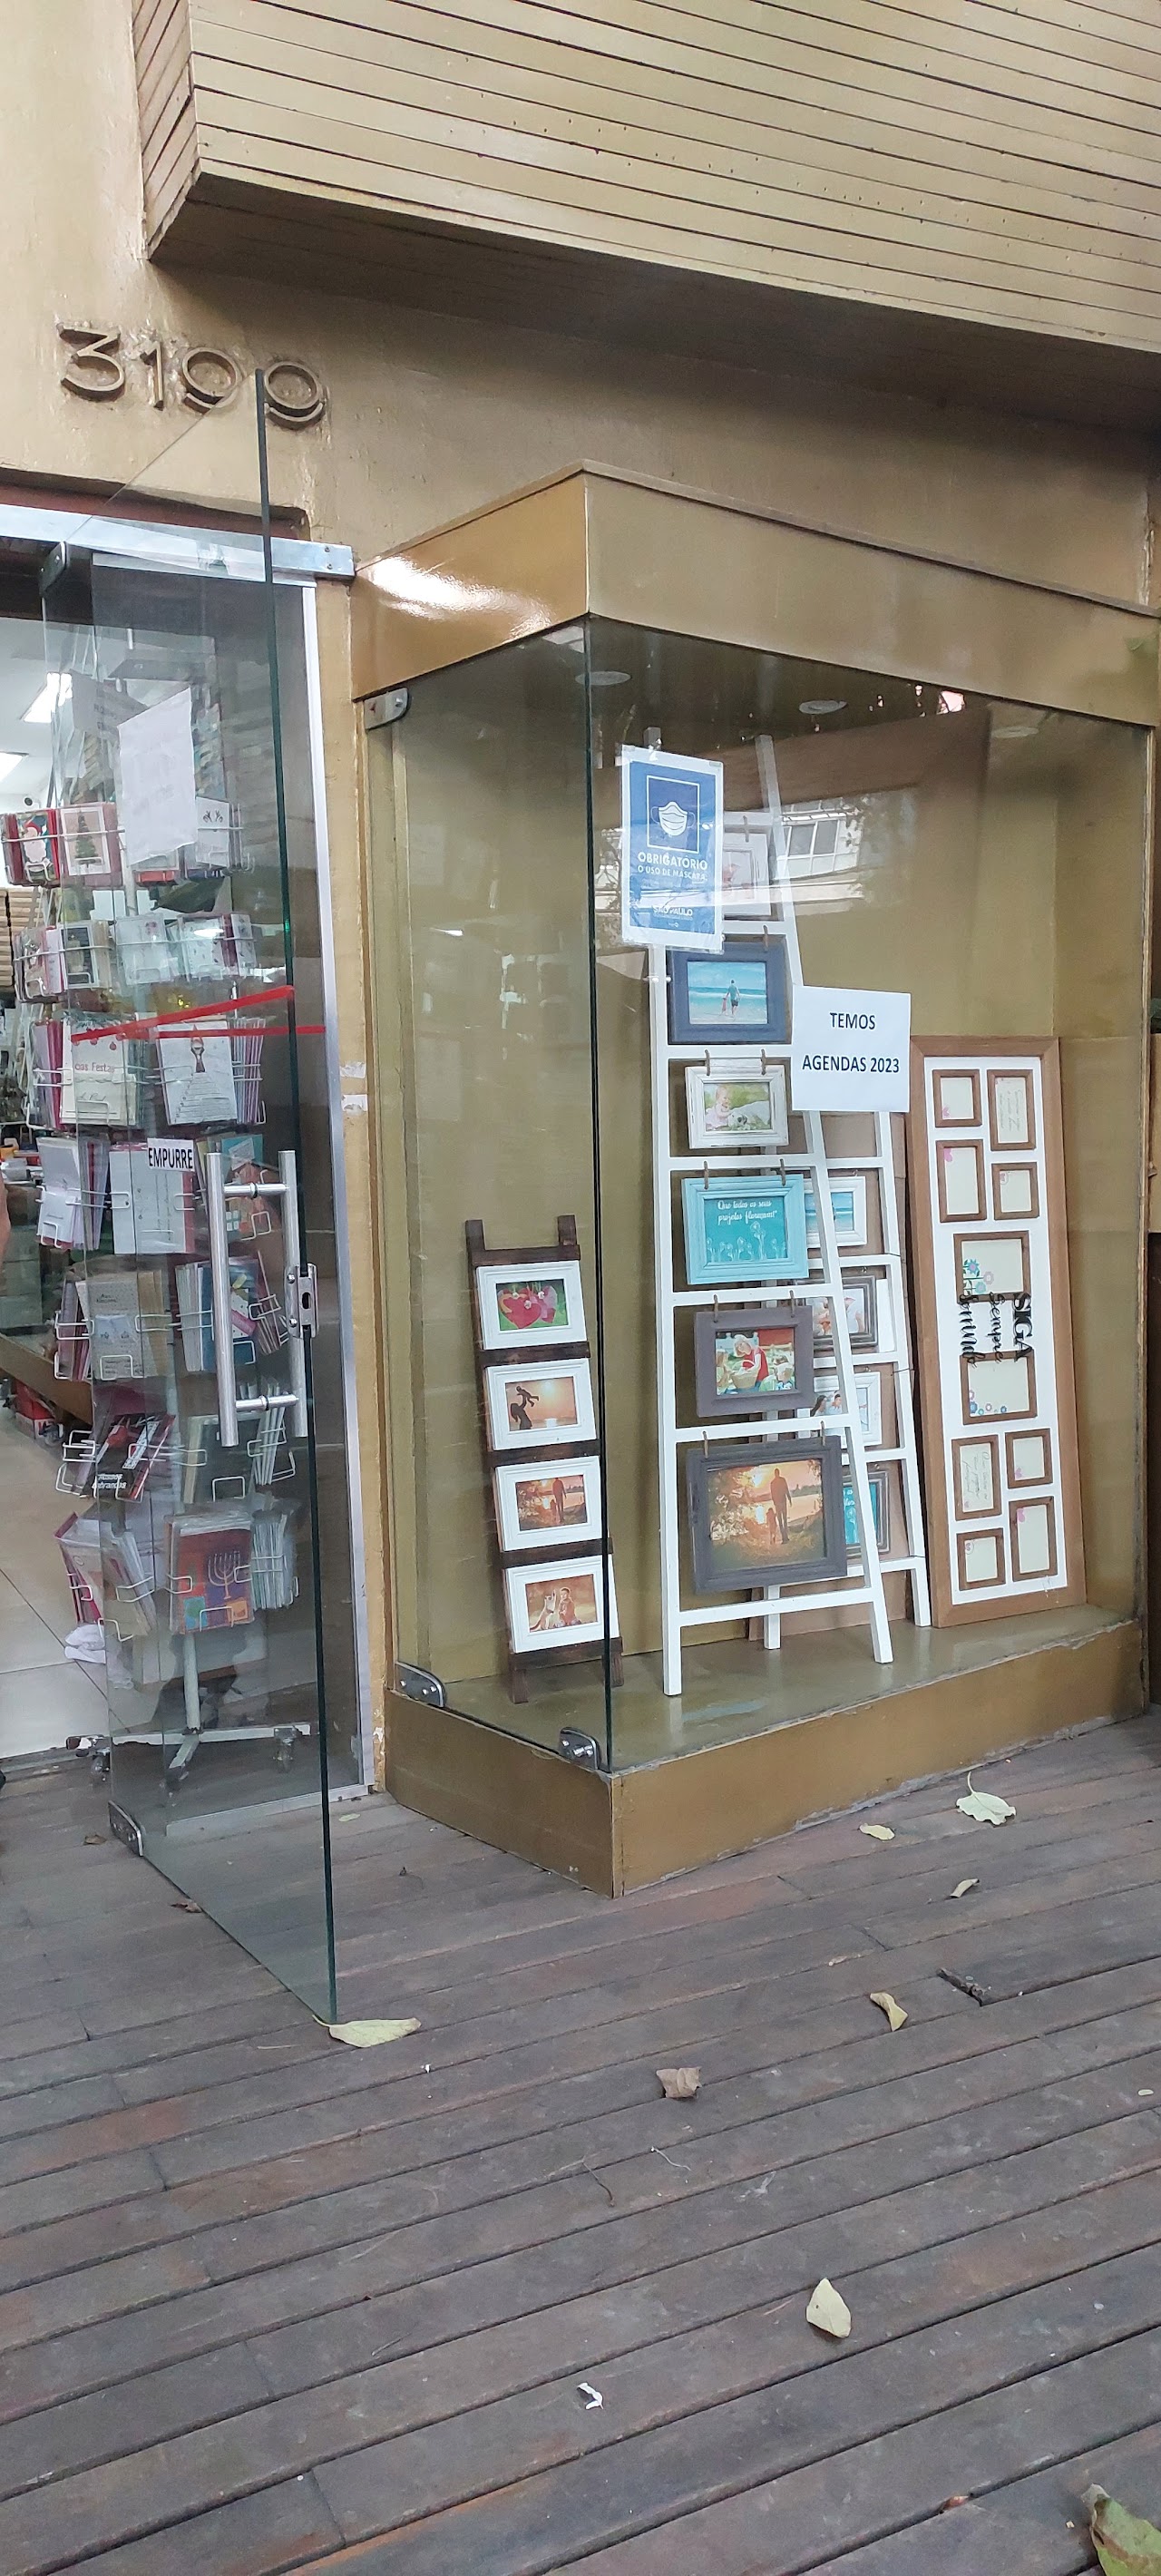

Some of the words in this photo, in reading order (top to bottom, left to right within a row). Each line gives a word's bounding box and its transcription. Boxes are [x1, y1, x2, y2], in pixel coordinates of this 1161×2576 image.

[56, 322, 327, 430] 3199
[638, 852, 707, 870] OBRIGATÓRIO
[638, 865, 644, 873] O
[645, 865, 660, 874] USO
[662, 868, 671, 876] DE
[829, 1011, 876, 1030] TEMOS
[802, 1054, 867, 1072] AGENDAS
[870, 1057, 900, 1073] 2023
[148, 1147, 193, 1169] EMPURRE
[1012, 1293, 1033, 1362] SIGA
